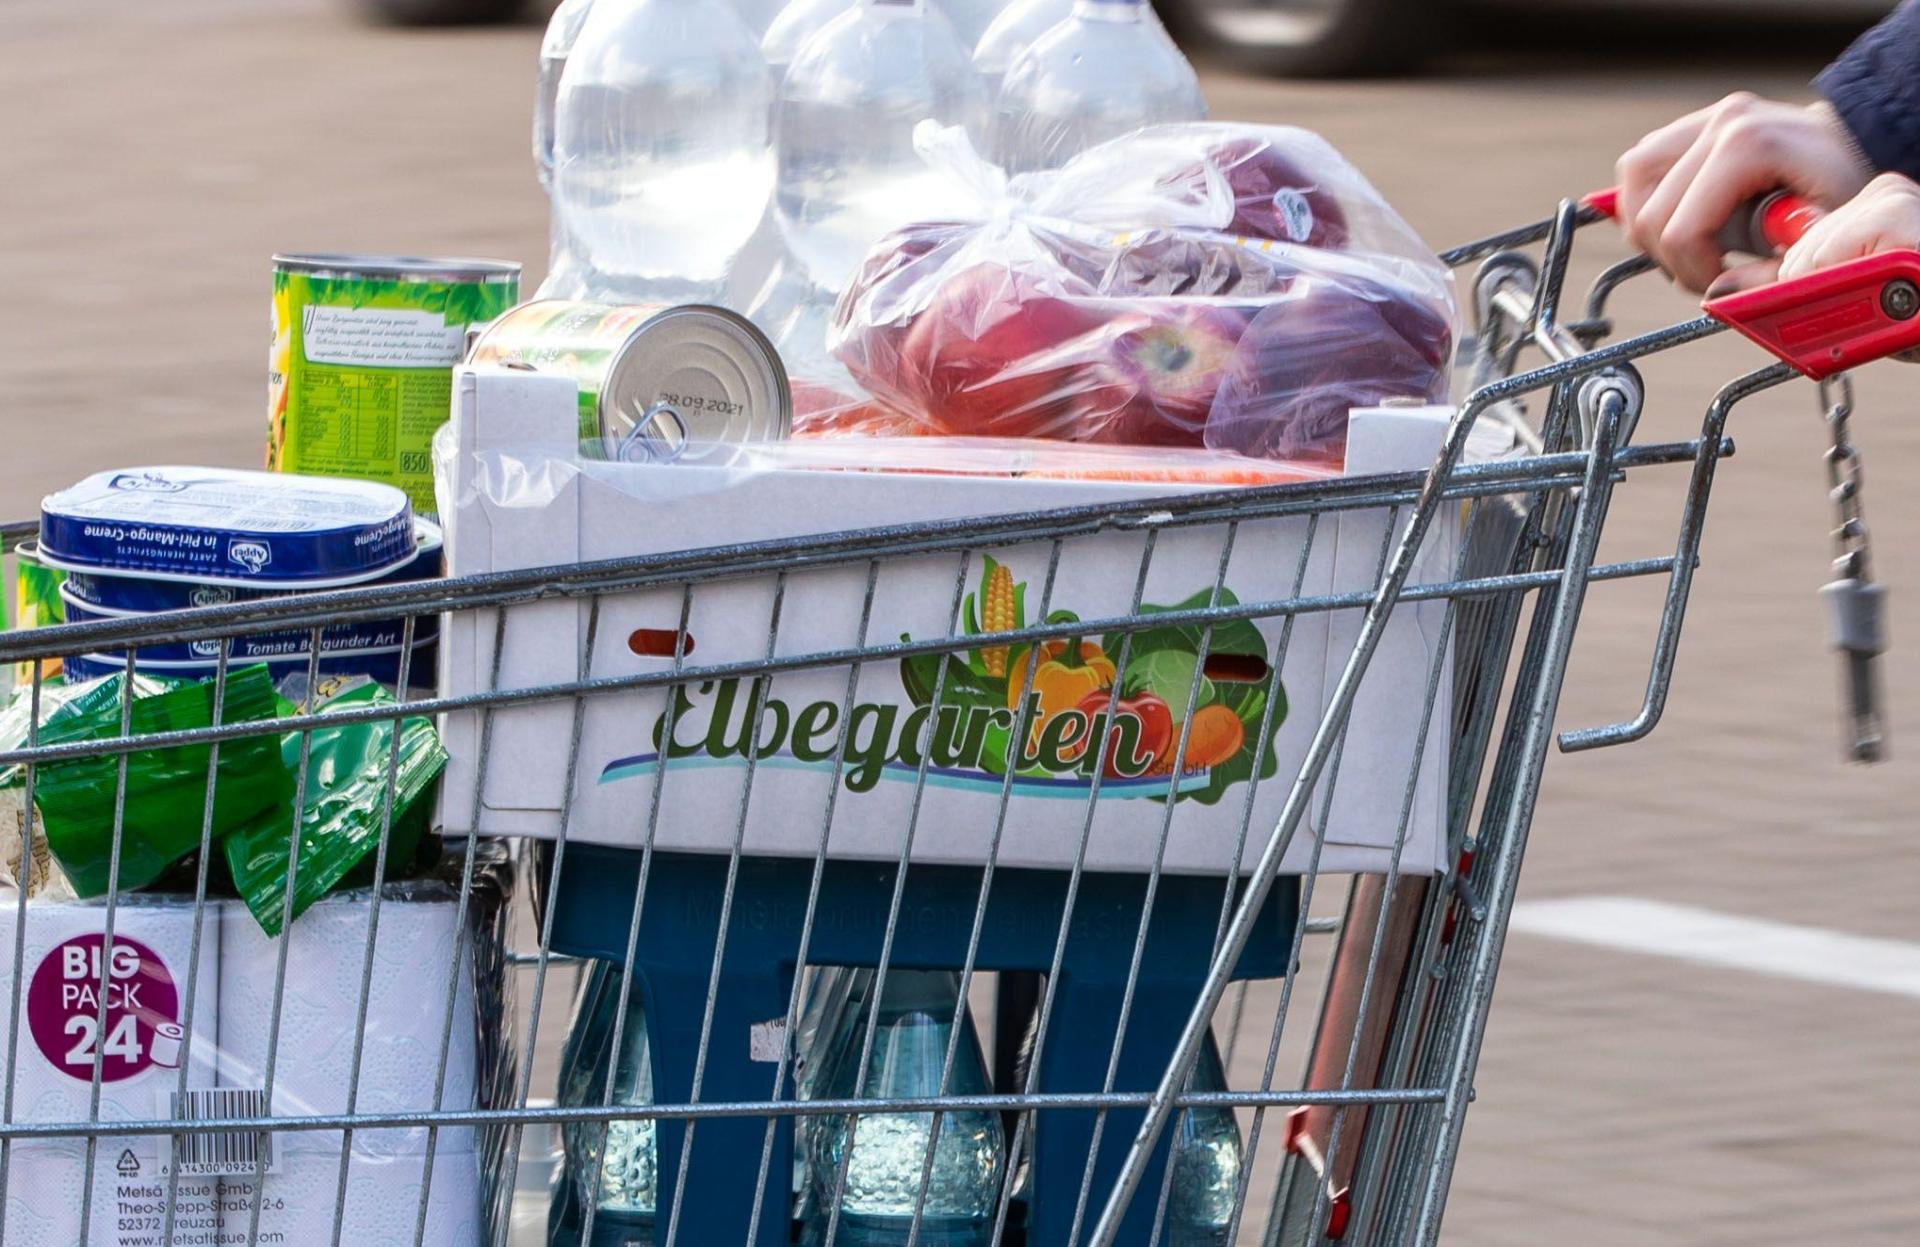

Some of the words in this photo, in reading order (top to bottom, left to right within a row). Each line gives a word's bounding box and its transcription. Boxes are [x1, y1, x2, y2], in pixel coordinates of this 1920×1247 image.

[403, 454, 427, 472] 850
[84, 525, 201, 548] Piri-Mango-Creme
[204, 535, 217, 549] in
[233, 546, 265, 559] Appel
[246, 642, 296, 655] Tomate
[300, 635, 371, 650] Bugunder
[374, 633, 395, 645] Art
[652, 674, 1155, 793] Elbegarten
[63, 945, 141, 980] BIG
[63, 983, 142, 1010] PACK
[64, 1015, 143, 1065] 24
[168, 1185, 210, 1197] ssue
[216, 1182, 256, 1196] Gmb
[117, 1198, 255, 1215] Theo-Sepp-Straß
[263, 1198, 284, 1210] 2-6
[118, 1218, 160, 1231] 52372
[172, 1218, 225, 1230] reuzau
[118, 1231, 284, 1247] www.etsatissue.om
